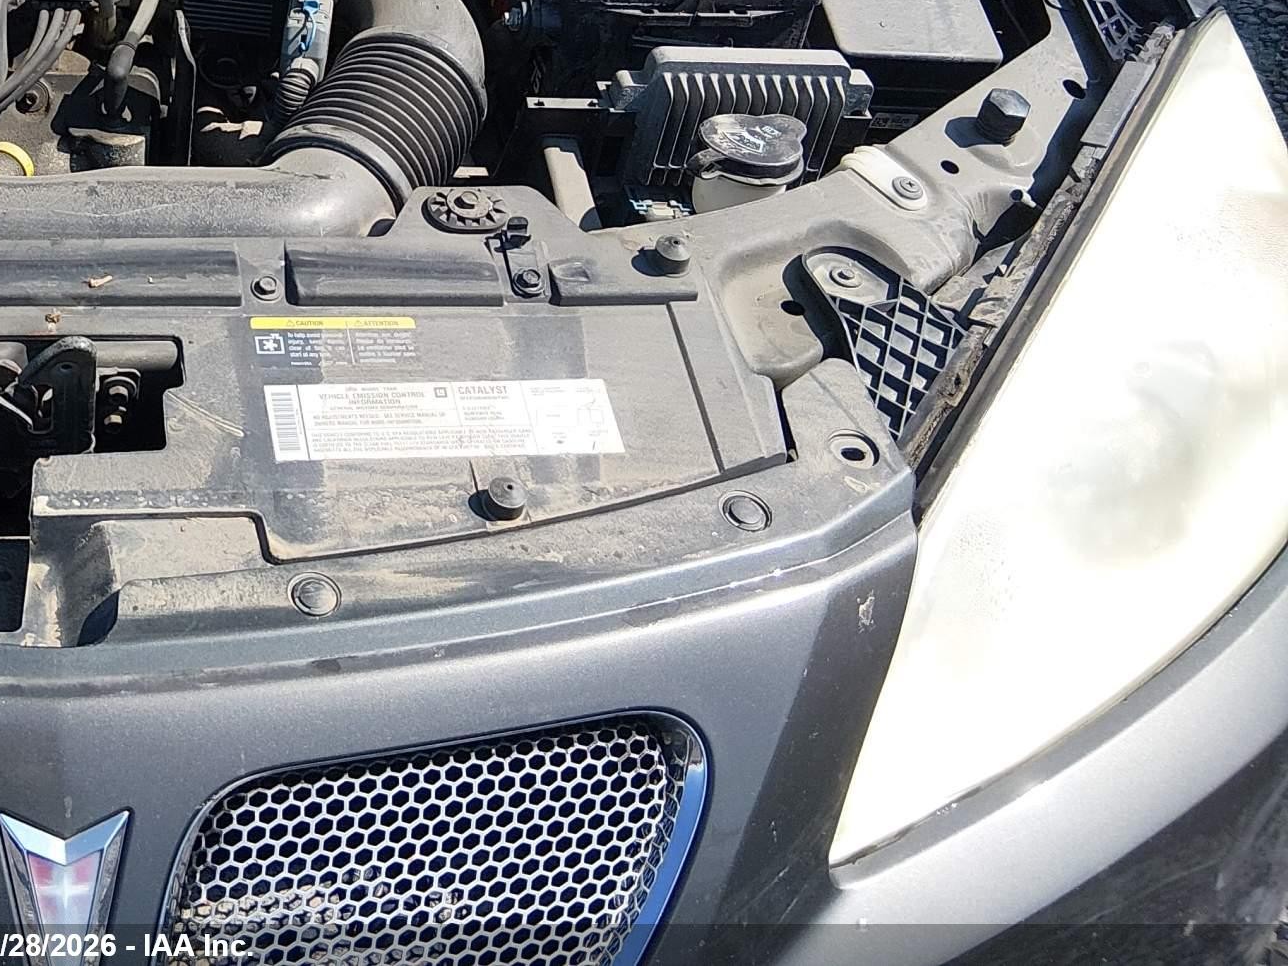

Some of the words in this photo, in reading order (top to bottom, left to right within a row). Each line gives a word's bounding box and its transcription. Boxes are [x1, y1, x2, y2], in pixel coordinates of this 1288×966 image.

[457, 385, 508, 395] CATALYST
[352, 392, 389, 400] EMISSION
[391, 391, 425, 399] CONTROL
